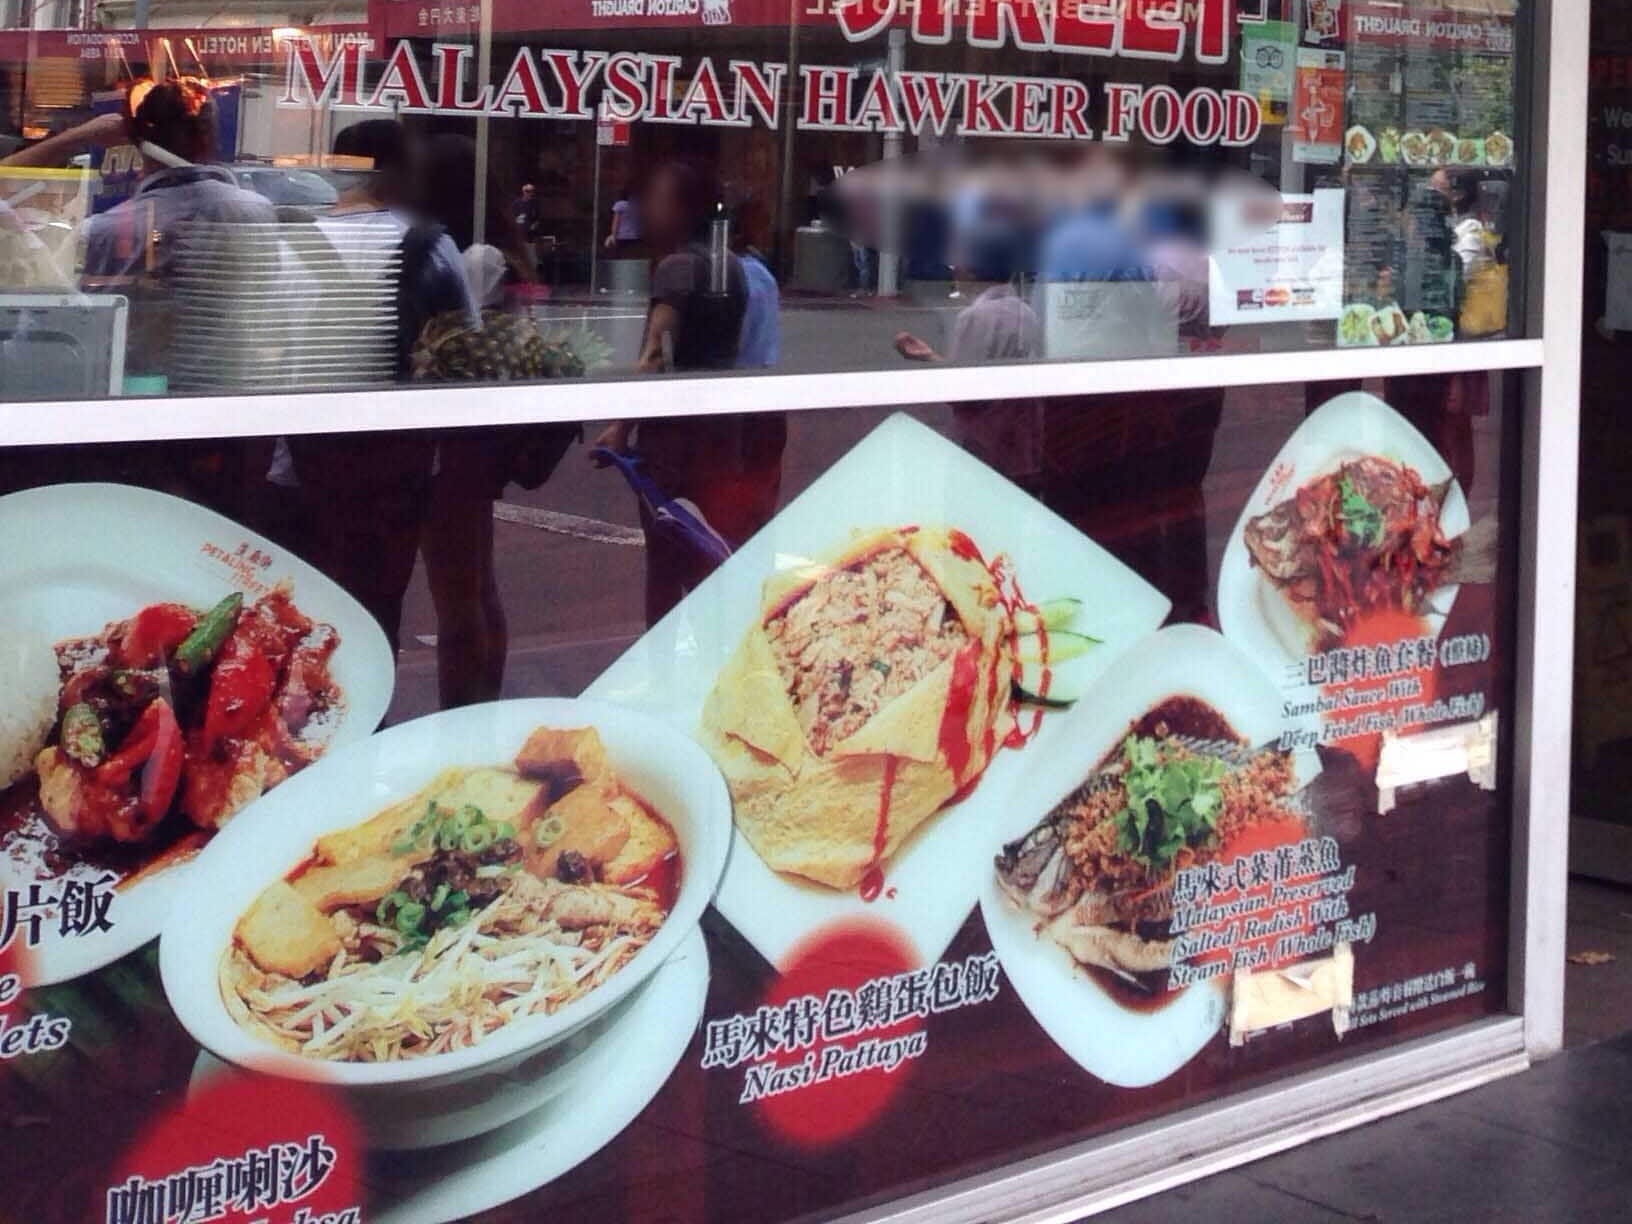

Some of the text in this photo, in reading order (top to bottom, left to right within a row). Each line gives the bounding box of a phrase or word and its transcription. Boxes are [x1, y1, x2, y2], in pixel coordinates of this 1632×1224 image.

[276, 37, 1262, 147] MALAYSIAN HAWKER FOOD
[1278, 728, 1319, 752] Deep
[1321, 715, 1362, 742] Fried
[1363, 709, 1396, 734] Fish
[1280, 676, 1423, 720] Sambal Sauce With
[1168, 895, 1350, 964] (Salted) Radish With
[1169, 865, 1357, 935] Malaysian Preserved
[1168, 912, 1377, 991] Steam Fish (Whole Fish)
[739, 1030, 927, 1105] Nasi Pattaya
